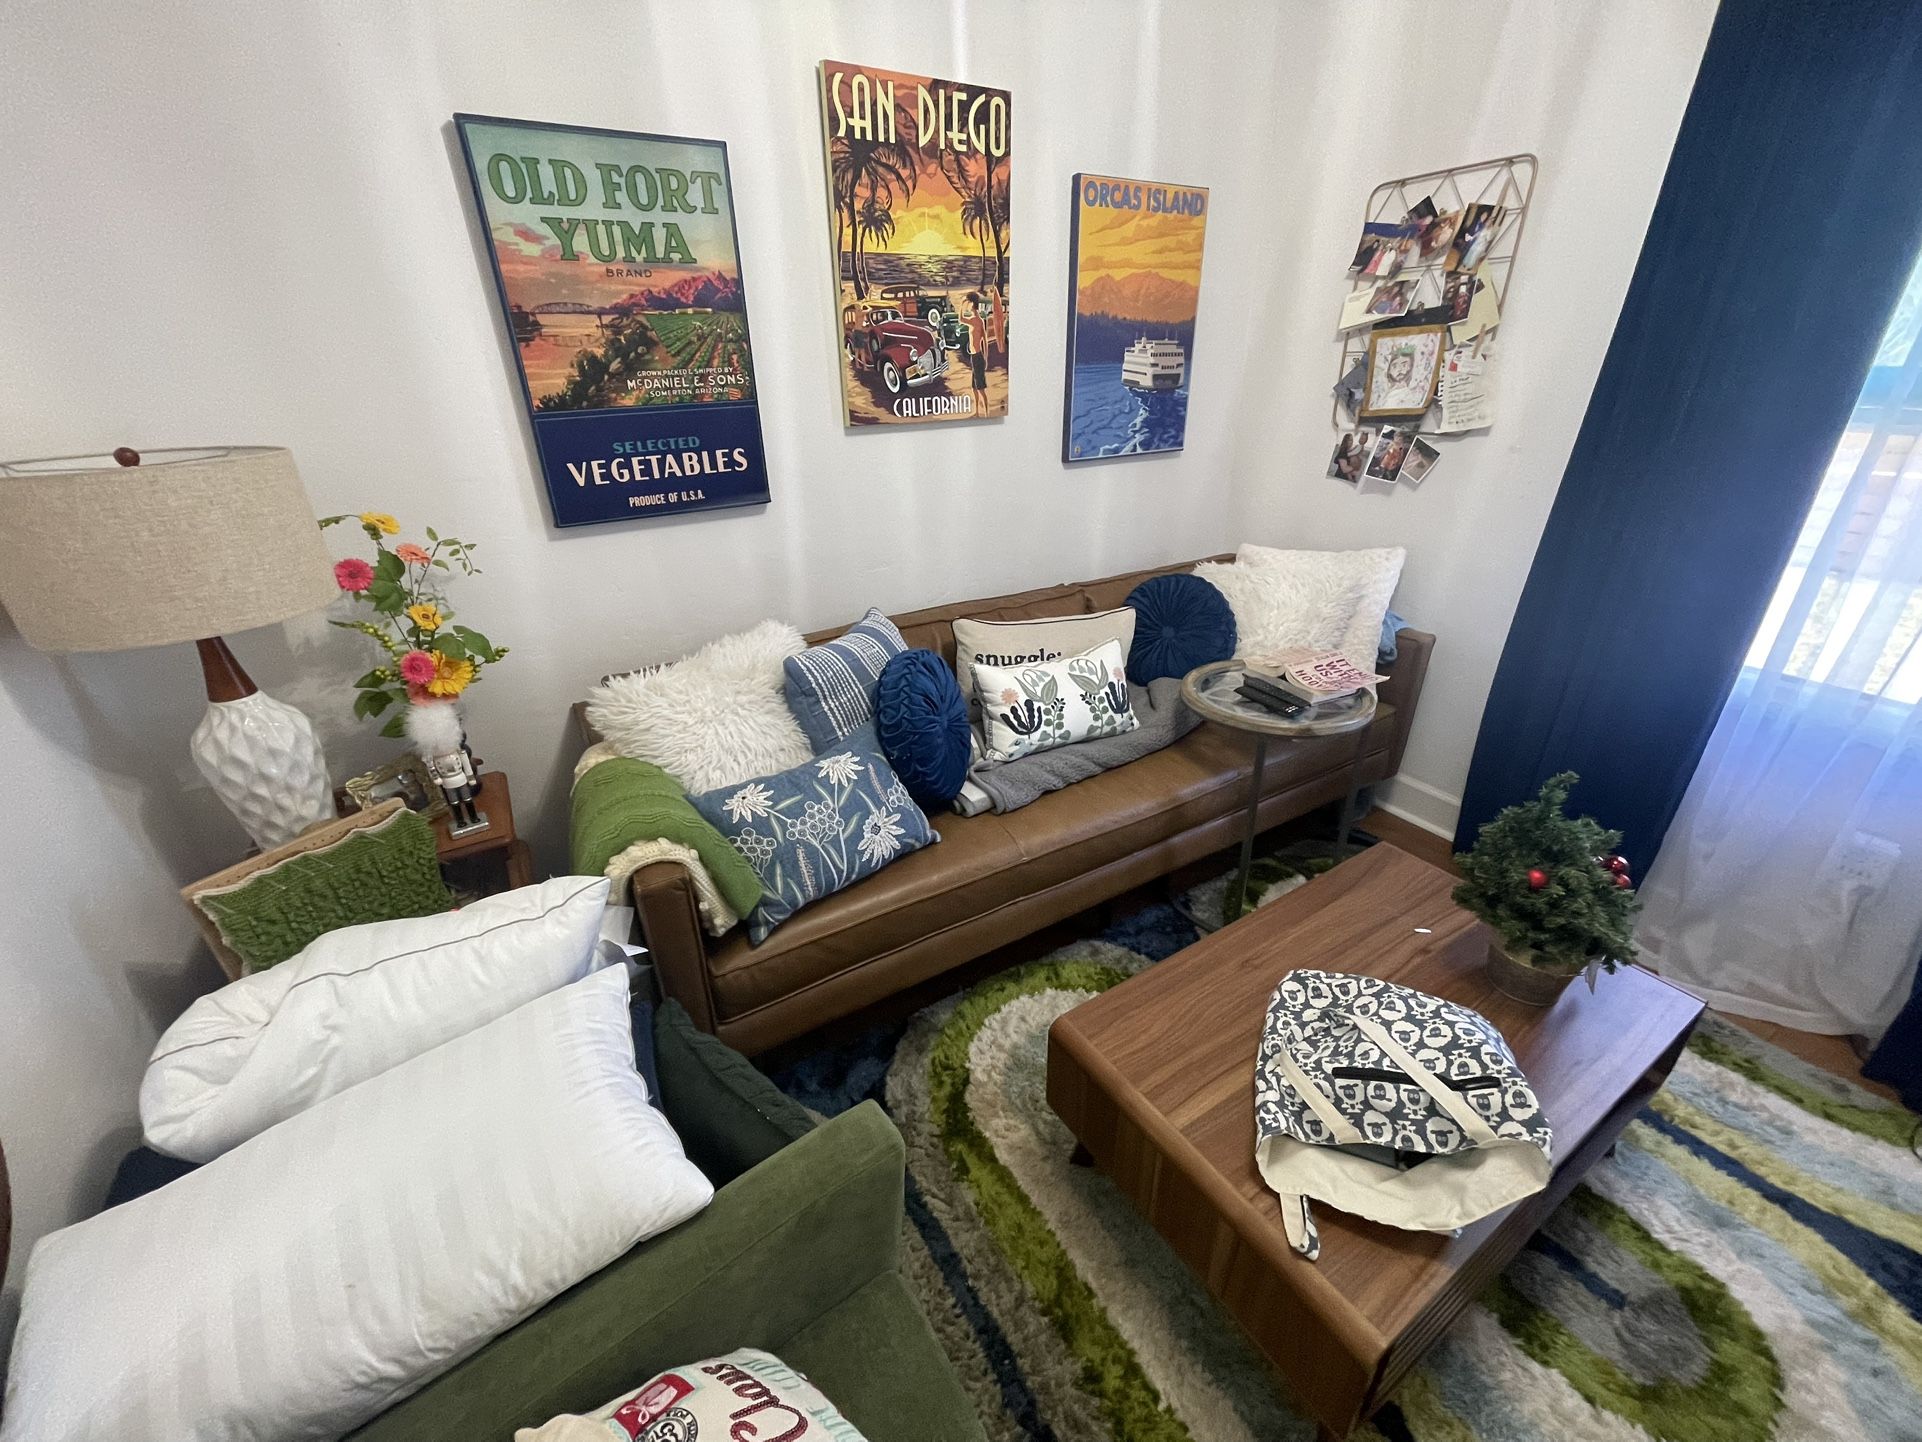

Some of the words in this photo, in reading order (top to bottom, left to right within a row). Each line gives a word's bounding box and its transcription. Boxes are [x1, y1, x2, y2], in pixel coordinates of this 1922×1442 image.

[831, 72, 896, 144] SAN
[917, 83, 1006, 157] DIEGO
[487, 153, 588, 207] OLD
[595, 163, 722, 214] FORT
[1083, 180, 1142, 211] ORCAS
[1146, 187, 1205, 217] ISLAND
[540, 217, 697, 264] YUMA
[605, 267, 653, 278] BRAND
[694, 367, 723, 375] SHIPPED
[708, 374, 745, 386] SONS
[695, 386, 729, 395] ARIZONA
[893, 394, 972, 417] CALIFORNIA
[612, 436, 700, 454] SELECTED
[566, 448, 748, 487] VEGETABLES
[628, 493, 667, 508] PRODUCE
[668, 492, 678, 503] OF
